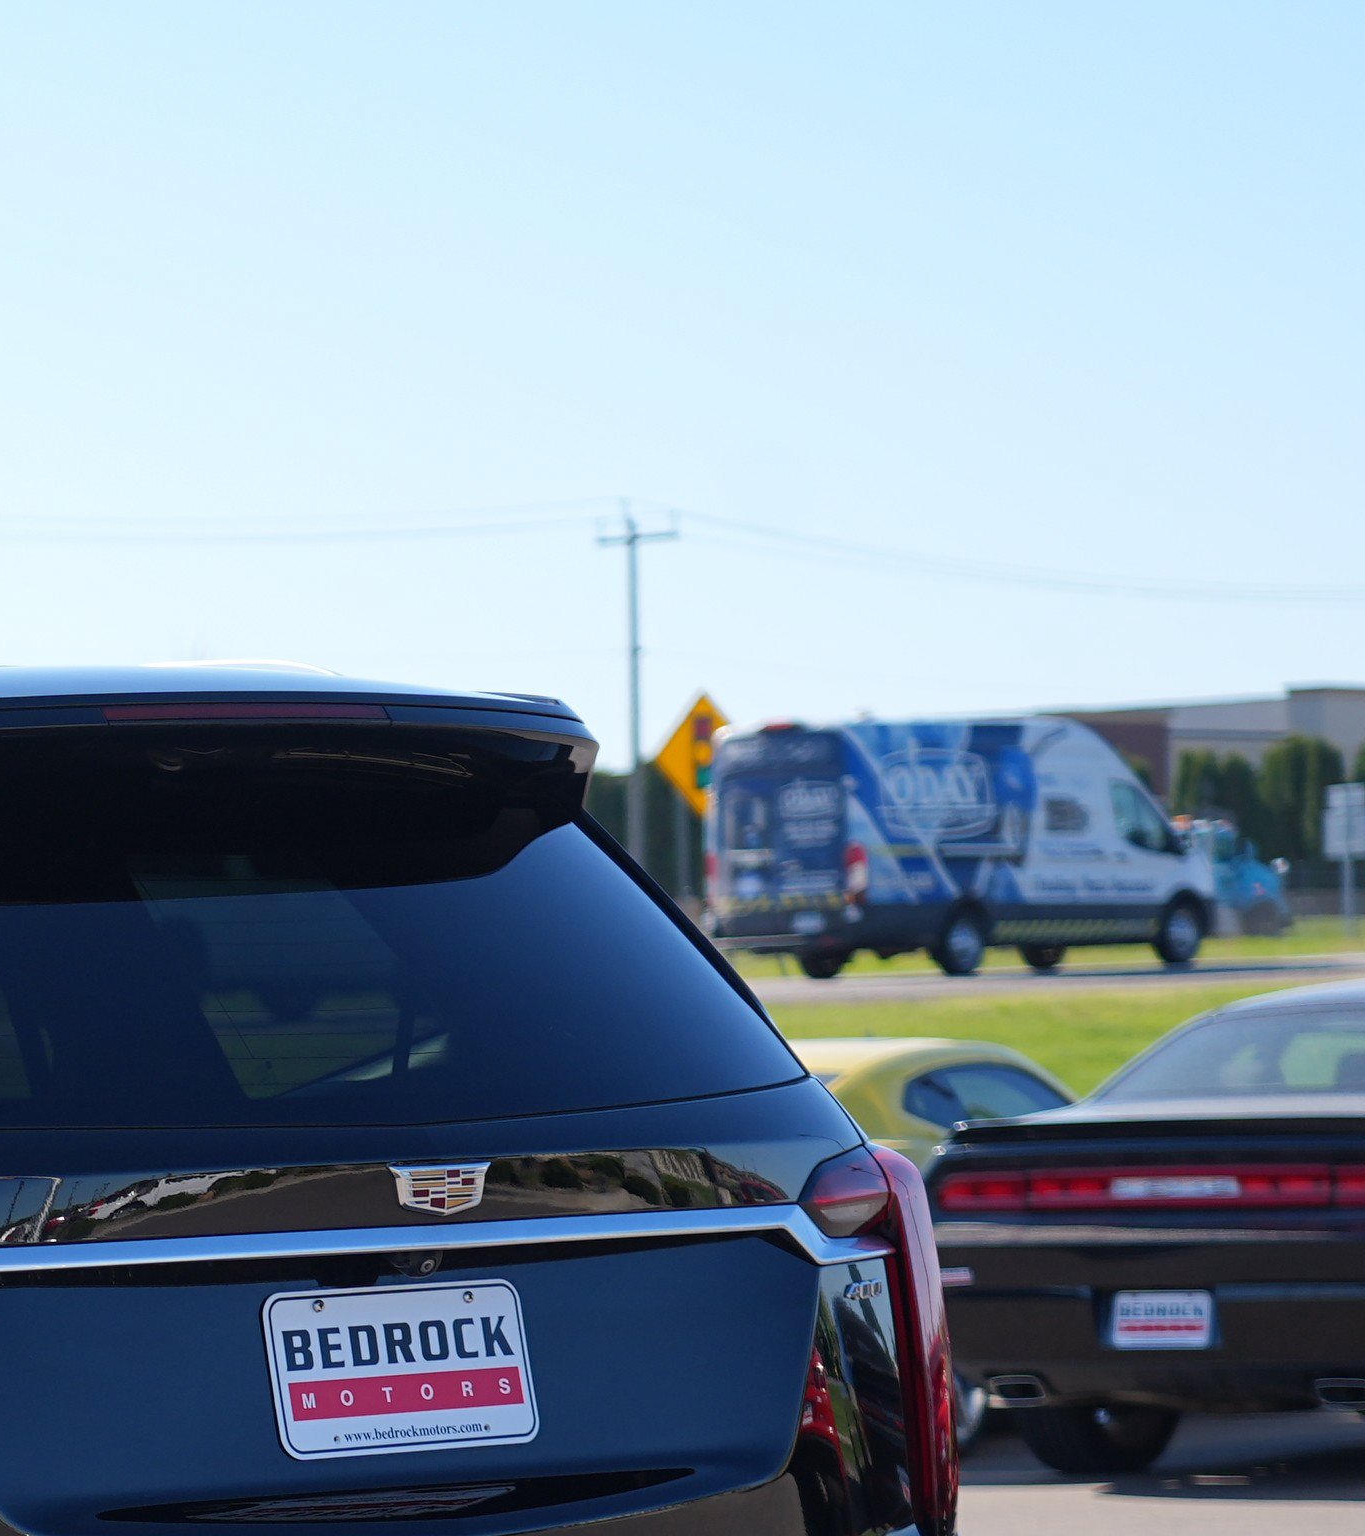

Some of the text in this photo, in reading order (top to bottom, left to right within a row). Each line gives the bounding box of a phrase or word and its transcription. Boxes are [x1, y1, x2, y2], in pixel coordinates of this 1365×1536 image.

[281, 1315, 515, 1372] BEDROCK
[301, 1378, 511, 1410] MOTORS
[344, 1421, 484, 1444] www.bedrockmotors.com
